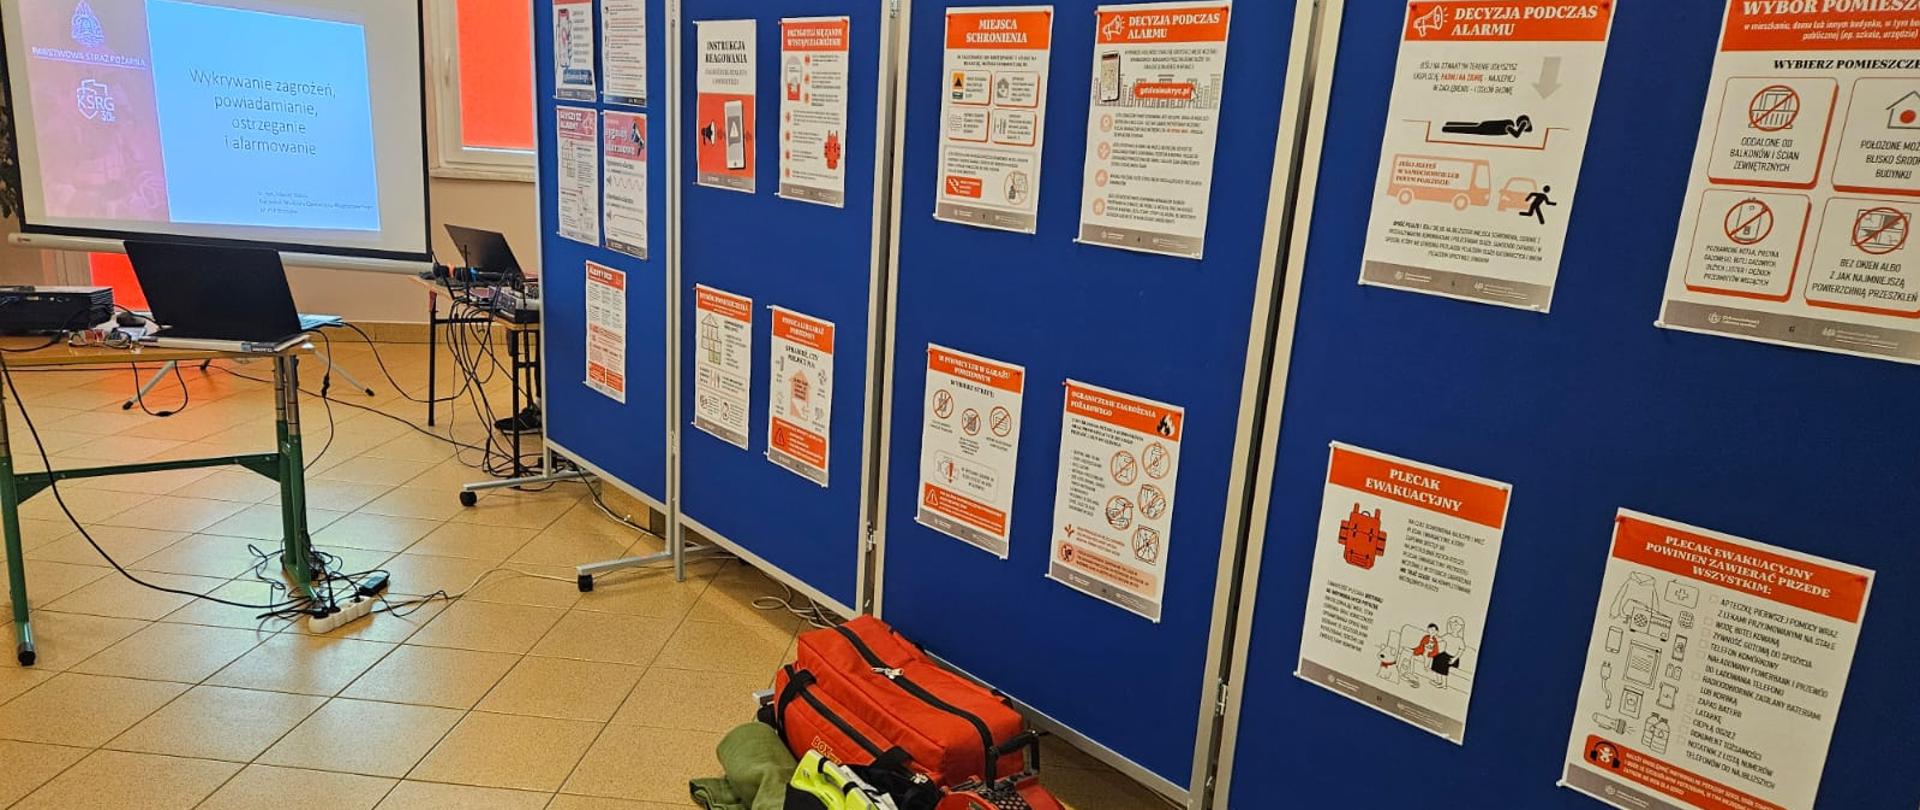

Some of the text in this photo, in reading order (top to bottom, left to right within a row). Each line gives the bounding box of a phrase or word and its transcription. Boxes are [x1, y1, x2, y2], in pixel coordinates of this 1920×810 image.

[1454, 5, 1598, 20] DECYZJA PODCZAS
[1822, 0, 1920, 13] POMIESZ
[979, 18, 1018, 30] MIEJSCA
[1129, 13, 1220, 27] DECYZJA PODCZAS
[966, 32, 1028, 43] SCHRONIENIA
[1127, 28, 1168, 40] ALARMU
[1451, 23, 1515, 36] ALARMU
[707, 40, 745, 51] INSTRUKCJA
[705, 53, 747, 64] REAGOWANIA
[1774, 59, 1834, 69] WYBIERZ
[189, 67, 336, 99] Wykrywanie zagrożeń,
[77, 94, 114, 111] KSRG
[214, 95, 318, 117] powiadamianie,
[232, 117, 306, 135] ostrzeganie
[233, 136, 316, 155] alarmowanie
[1740, 136, 1793, 147] ODDALONE OD
[1860, 140, 1901, 150] POŁOŻONE
[1729, 146, 1771, 159] BALKONÓW
[1775, 148, 1801, 161] ŚCIAN
[1865, 154, 1895, 165] BLISKO
[1732, 160, 1791, 174] ZEWNĘTRZNYCH
[1875, 168, 1913, 179] BUDYNKU
[1838, 257, 1902, 273] BEZ OKIEN ALBO
[1835, 270, 1852, 281] JAK
[1851, 272, 1906, 289] NAJMNIEJSZĄ
[1810, 281, 1919, 303] POWIERZCHNIĄ PRZESZKLEŃ
[1071, 390, 1156, 419] OGRANICZENIE ZAGROŻENIA
[1071, 400, 1113, 417] POŻAROWEGO
[1389, 468, 1441, 491] PLECAK
[1365, 477, 1463, 512] EWAKUACYJNY
[1665, 536, 1813, 580] PLECAK EWAKUACYJNY
[1646, 543, 1831, 597] POWINIEN ZAWIERAĆ PRZEDE
[1692, 566, 1773, 593] WSZYSTKIM:
[1720, 599, 1839, 637] APTECZKĘ PIERWSZEJ POMOCY WRAZ
[1715, 621, 1734, 633] WODĘ
[1723, 611, 1746, 623] LEKAMI
[1803, 635, 1814, 643] NA
[1815, 638, 1836, 650] STAŁE
[1711, 643, 1780, 669] TELEFON KOMÓRKOWY
[1771, 649, 1781, 658] DO
[1705, 665, 1785, 695] DO ŁADOWANIA TELEFONU
[1707, 655, 1750, 673] NAŁADOWANY
[1750, 668, 1791, 686] POWERBANK
[1795, 681, 1829, 697] PRZEWÓD
[1700, 687, 1712, 696] LUB
[1698, 697, 1718, 709] ZAPAS
[1694, 708, 1723, 724] LATARKĘ
[1690, 730, 1723, 745] DOKUMENT
[1688, 740, 1718, 755] NOTATNIK
[1722, 752, 1741, 765] LISTĄ
[1740, 759, 1774, 776] NUMERÓW
[1685, 750, 1776, 788] TELEFONÓW DO NAJBLIŻSZYCH
